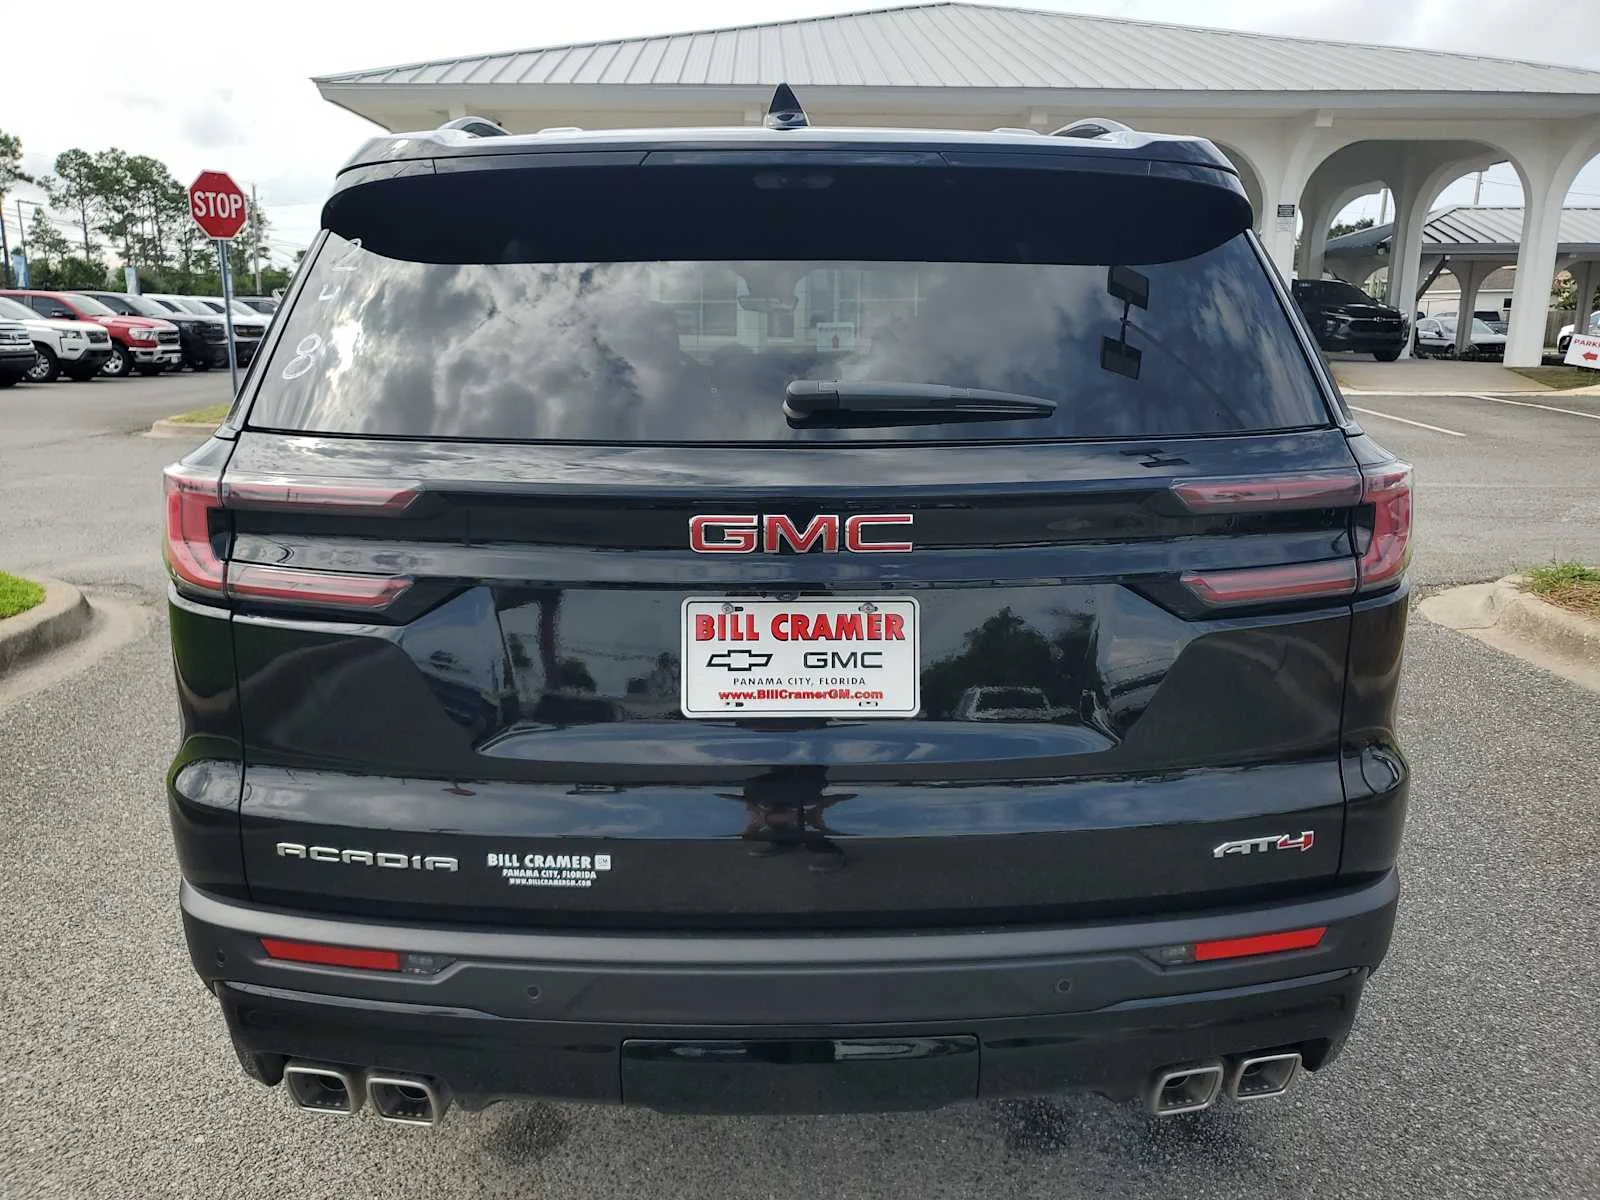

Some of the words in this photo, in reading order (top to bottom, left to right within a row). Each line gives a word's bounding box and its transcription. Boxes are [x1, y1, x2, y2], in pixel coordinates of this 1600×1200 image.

[193, 190, 243, 219] STOP
[1574, 338, 1600, 349] PARK
[689, 514, 914, 553] GMC
[695, 613, 760, 642] BILL
[771, 613, 906, 642] CRAMER
[803, 651, 883, 669] GMC
[733, 677, 783, 686] PANAMA
[787, 677, 815, 687] CITY,
[819, 677, 866, 686] FLORIDA
[1213, 830, 1314, 858] AT4
[276, 842, 459, 872] ACADIA
[487, 853, 520, 867] BILL
[524, 854, 592, 869] CRAMER
[502, 868, 540, 877] PANAMA
[541, 870, 561, 879] CITY,
[562, 870, 597, 879] FLORIDA
